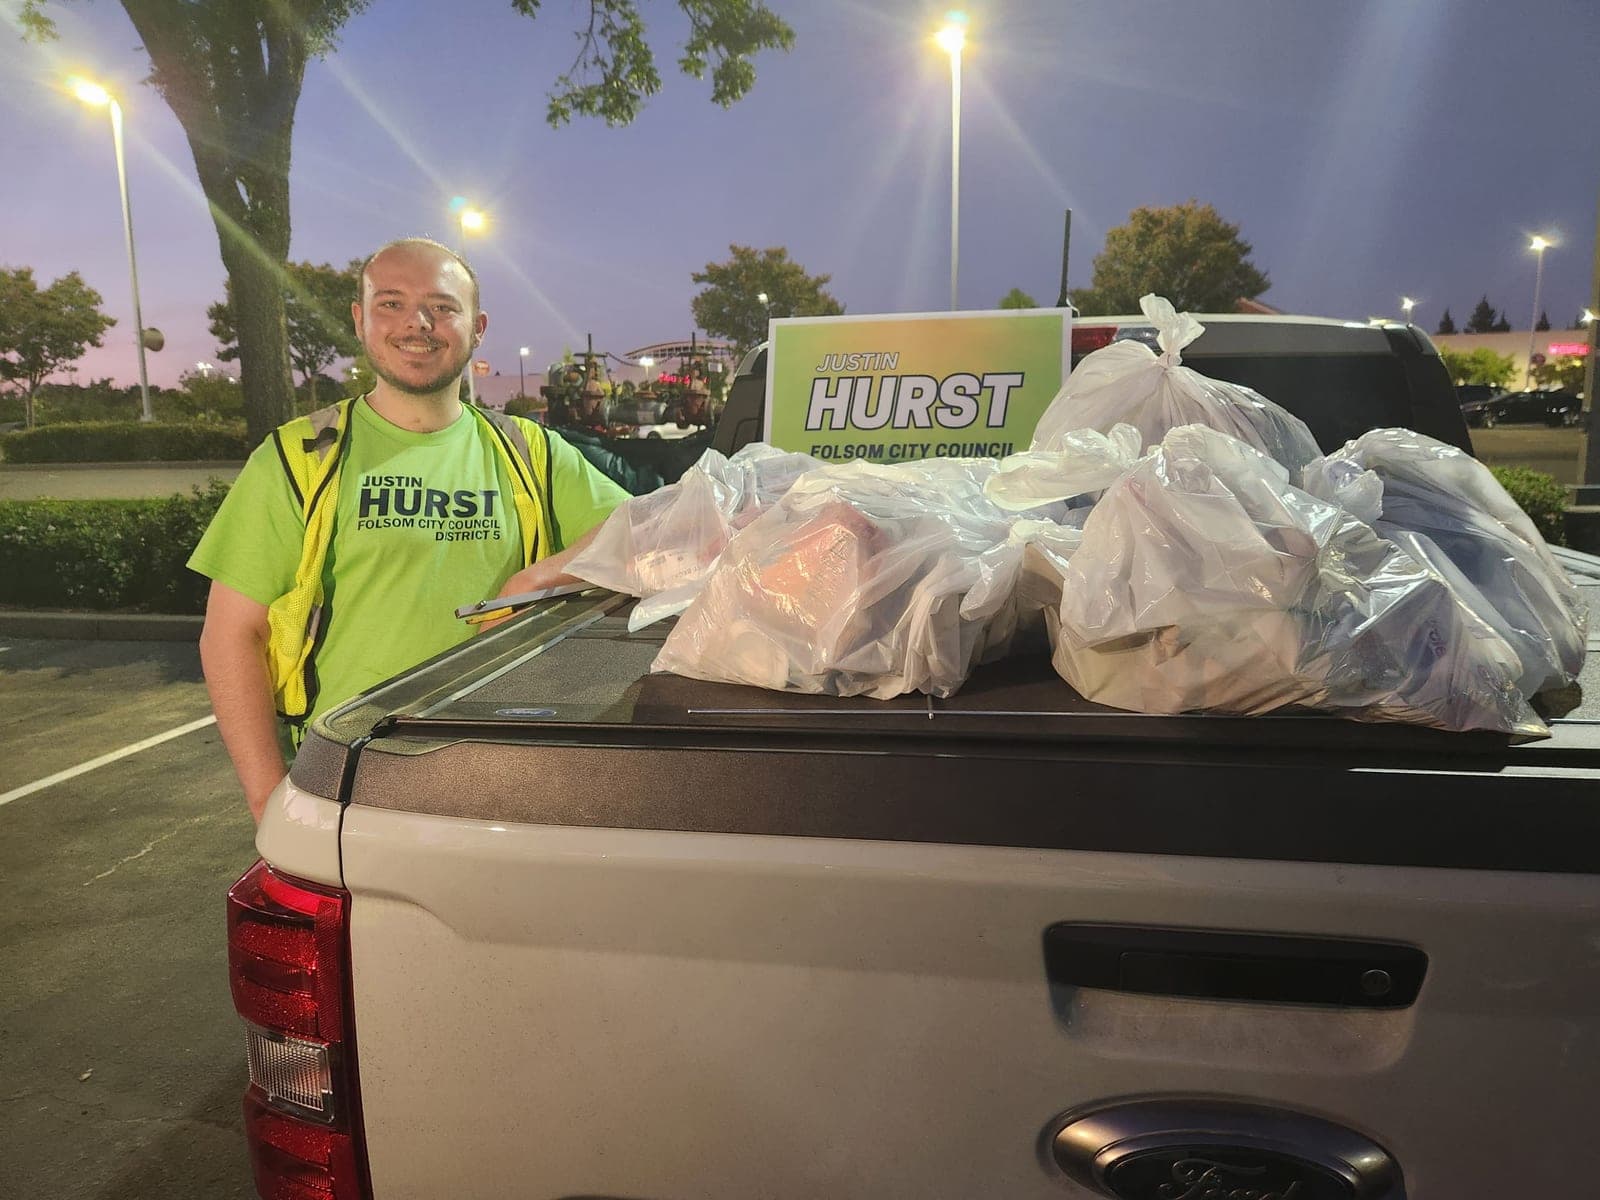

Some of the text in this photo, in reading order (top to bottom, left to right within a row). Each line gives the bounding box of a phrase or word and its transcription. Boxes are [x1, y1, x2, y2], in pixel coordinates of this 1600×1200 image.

[816, 352, 899, 372] JUSTIN
[805, 372, 1024, 431] HURST
[810, 444, 884, 459] FOLSOM
[889, 443, 931, 459] CITY
[363, 476, 422, 487] JUSTIN
[358, 488, 499, 518] HURST
[358, 518, 500, 531] FOLSOM CITY COUNCIL
[435, 530, 500, 541] DISTRICT 5
